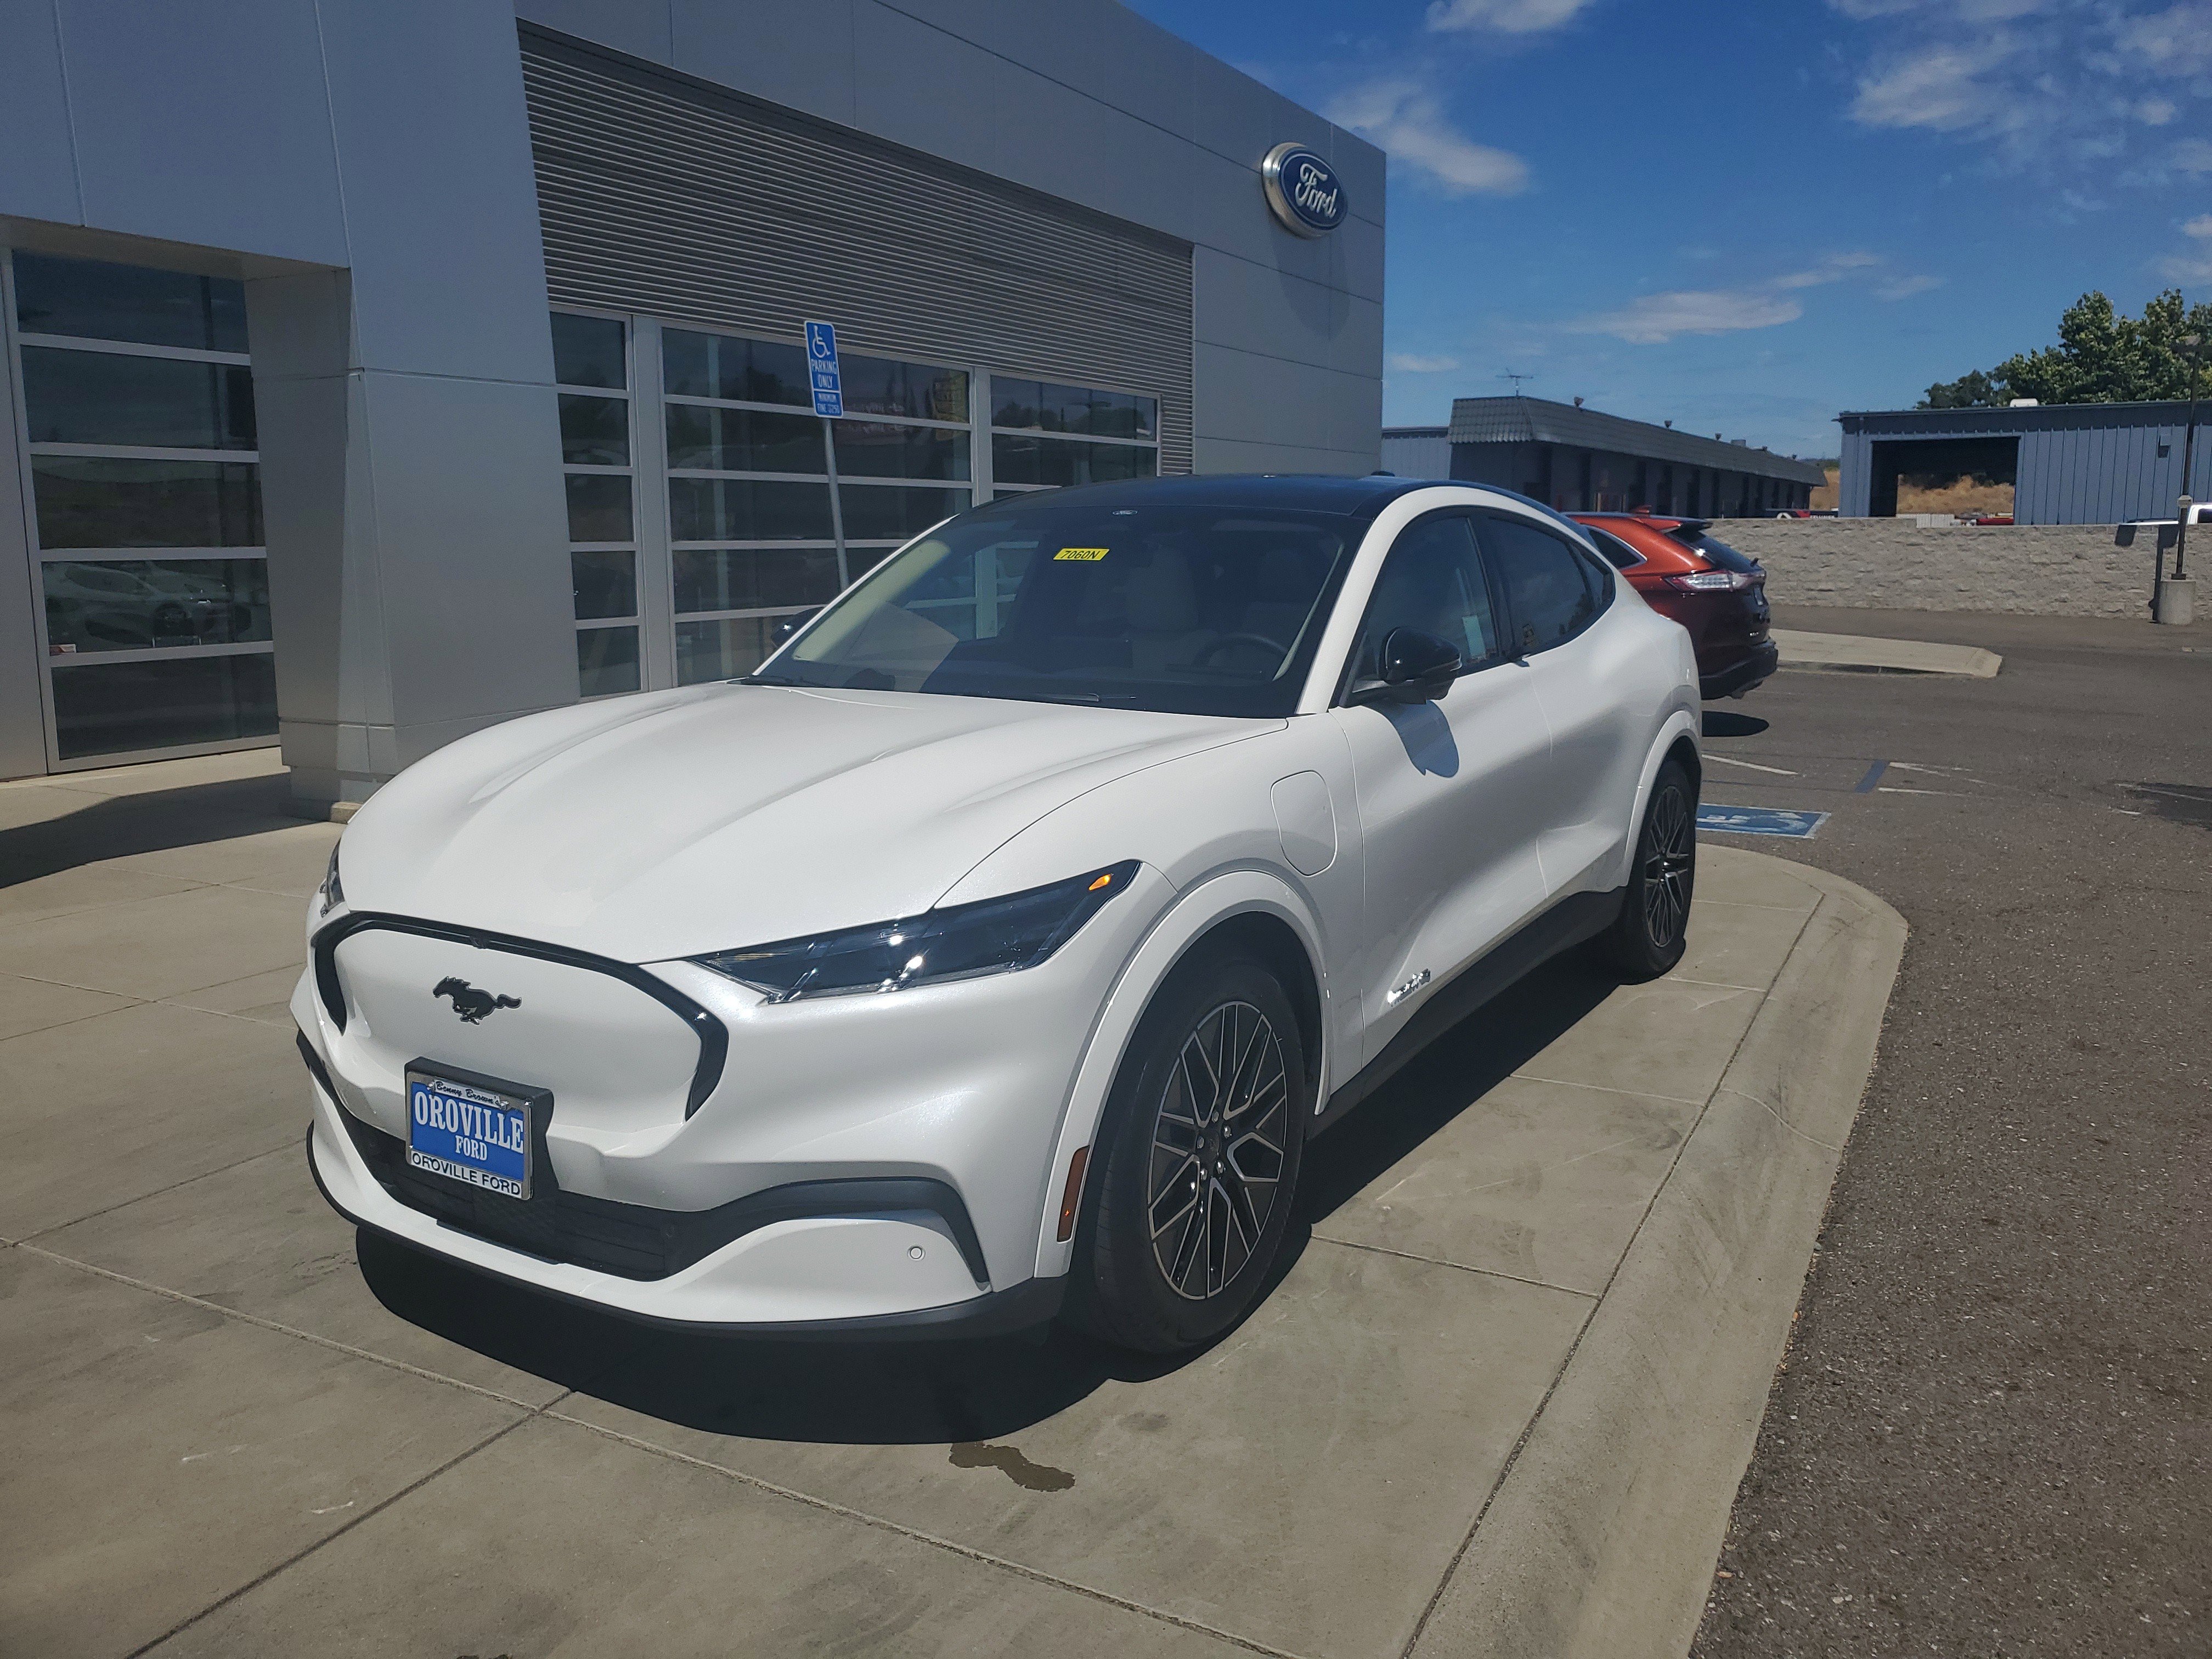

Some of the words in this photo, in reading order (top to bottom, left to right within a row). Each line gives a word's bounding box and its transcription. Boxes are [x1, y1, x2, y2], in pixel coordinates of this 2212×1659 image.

[1295, 163, 1338, 218] Ford
[811, 359, 837, 374] PARKING
[817, 375, 833, 388] ONLY
[1060, 550, 1101, 559] 7060N
[435, 1081, 462, 1097] Benny
[465, 1088, 500, 1105] Brown's
[415, 1091, 524, 1154] OROVILLE
[455, 1135, 488, 1161] FORD
[412, 1152, 478, 1183] OROVILLE
[482, 1173, 521, 1196] FORD
